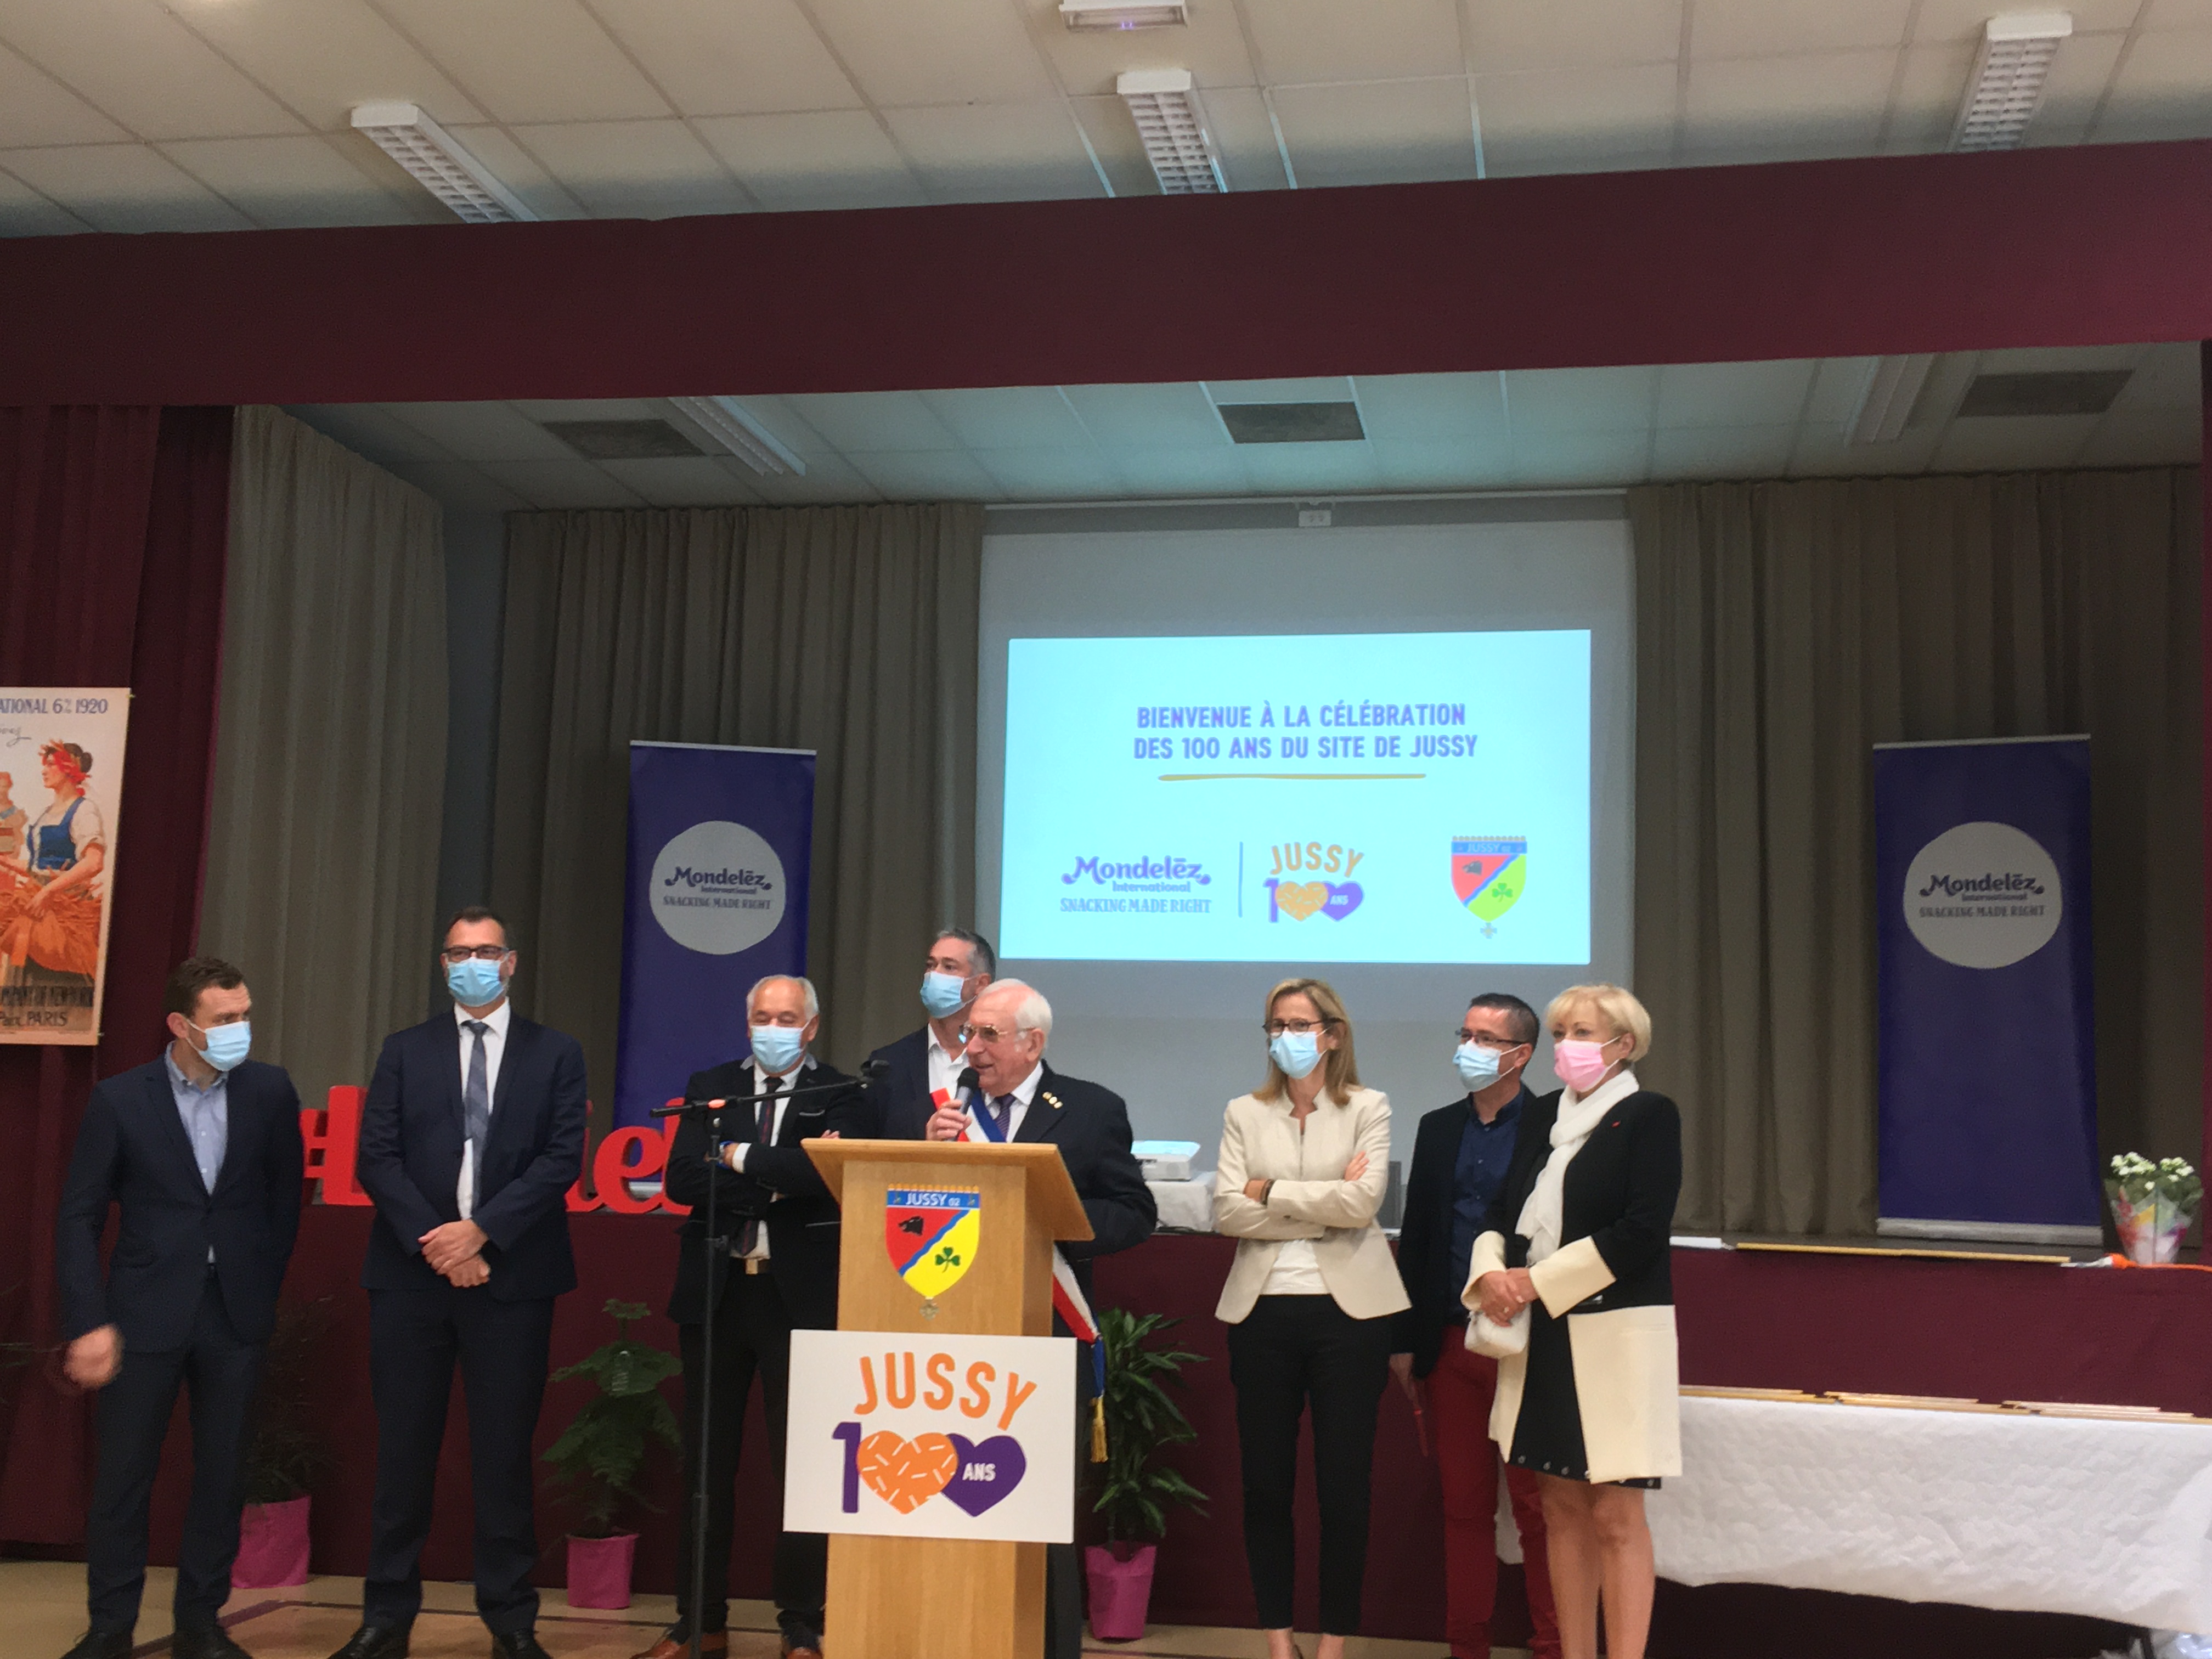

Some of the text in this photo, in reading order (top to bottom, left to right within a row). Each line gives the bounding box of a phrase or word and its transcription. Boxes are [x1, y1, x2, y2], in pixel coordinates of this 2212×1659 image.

[76, 698, 108, 714] 1920
[1137, 699, 1466, 728] BIENVENUE À LA CÉLÉBRATION
[1133, 735, 1477, 759] DES 100 ANS DU SITE DE JUSSY
[1468, 843, 1500, 853] JUSSY
[1270, 841, 1364, 878] JUSSY
[664, 866, 772, 890] Mondelēz
[1061, 856, 1211, 885] Mondelēz
[1112, 880, 1190, 893] International
[1918, 872, 2045, 897] Mondelēz
[713, 897, 740, 909] MADE
[741, 898, 771, 910] RIGHT
[1060, 898, 1212, 913] SNACKING MADE RIGHT
[1330, 895, 1349, 906] ANS
[1977, 906, 2007, 917] MADE
[2010, 905, 2044, 916] RIGHT
[27, 1011, 67, 1026] PARIS
[906, 1192, 947, 1206] JUSSY
[853, 1351, 1037, 1432] JUSSY
[962, 1462, 996, 1482] ANS
